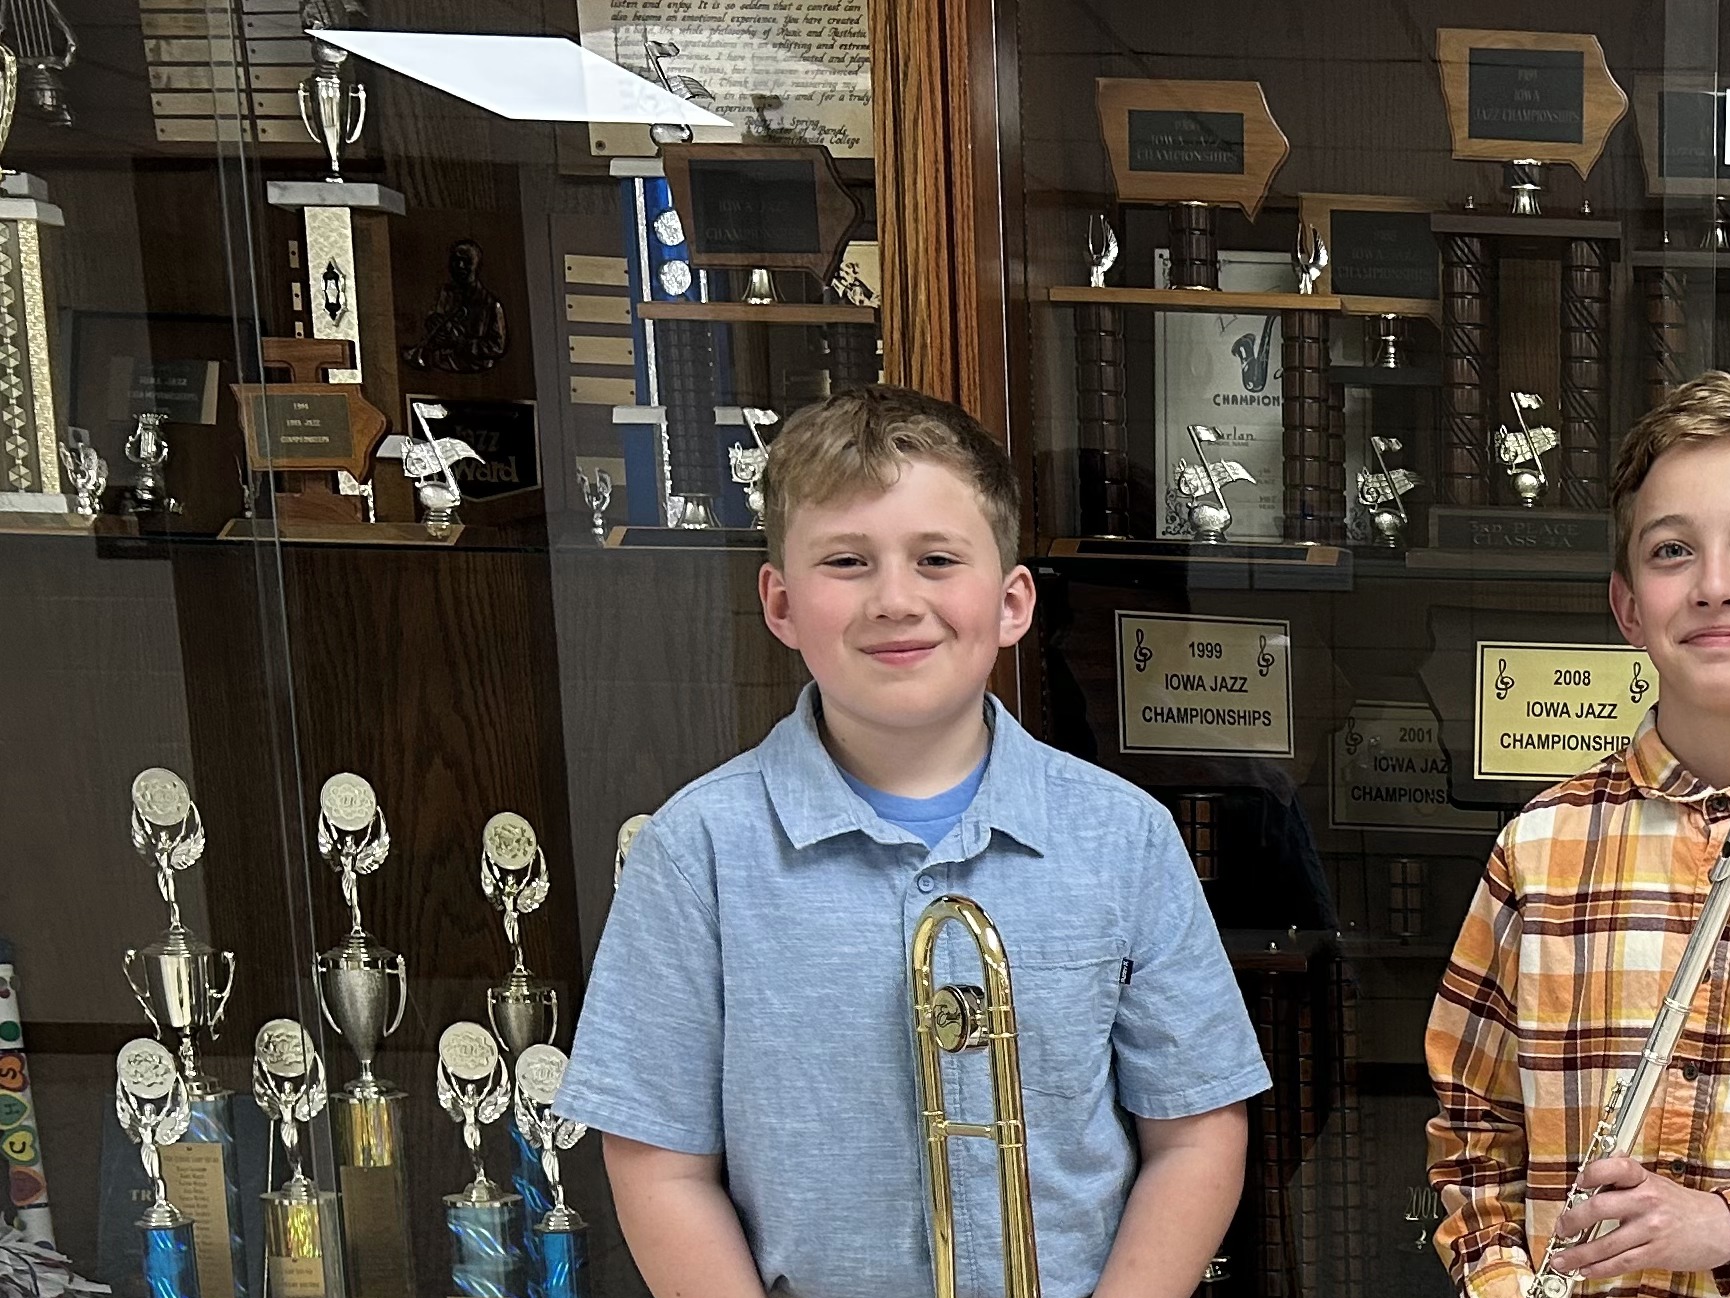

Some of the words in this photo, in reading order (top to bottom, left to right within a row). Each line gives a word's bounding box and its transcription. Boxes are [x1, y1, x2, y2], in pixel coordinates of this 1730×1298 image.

[807, 26, 826, 37] and
[1212, 394, 1281, 408] CHAMPION
[451, 456, 519, 483] ward
[1188, 641, 1223, 659] 1999
[1165, 673, 1206, 691] IOWA
[1209, 676, 1248, 693] JAZZ
[1553, 669, 1591, 686] 2008
[1141, 705, 1272, 727] CHAMPIONSHIPS
[1526, 701, 1571, 718] IOWA
[1575, 703, 1618, 719] JAZZ
[1399, 727, 1433, 743] 2001
[1500, 732, 1631, 751] CHAMPIONSHIP
[1374, 756, 1416, 773] IOWA
[1420, 758, 1449, 774] JAZ
[1351, 785, 1448, 805] CHAMPIONS
[1404, 1186, 1439, 1220] 2001
